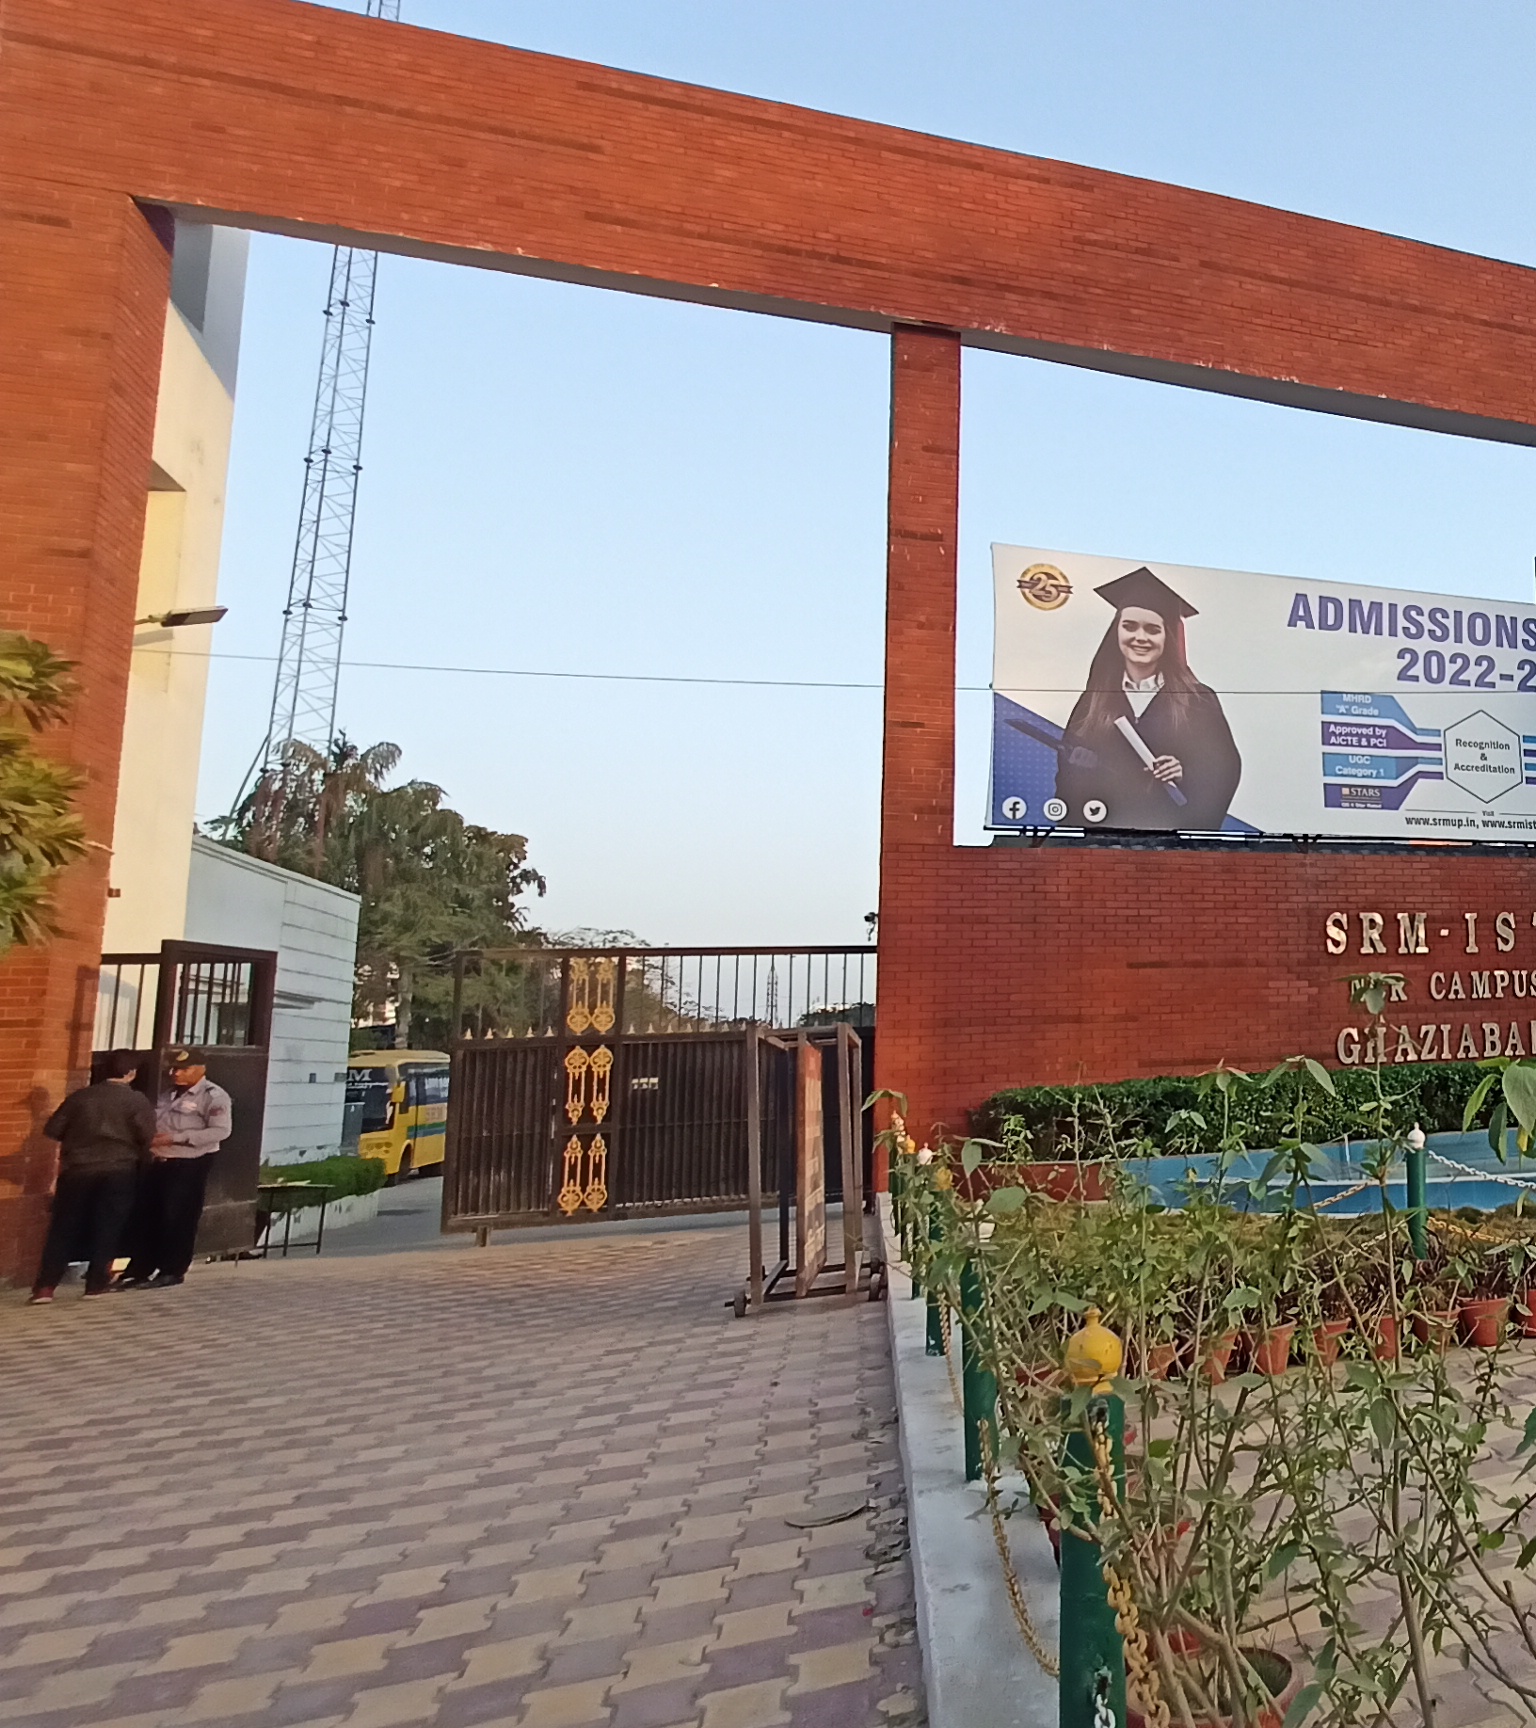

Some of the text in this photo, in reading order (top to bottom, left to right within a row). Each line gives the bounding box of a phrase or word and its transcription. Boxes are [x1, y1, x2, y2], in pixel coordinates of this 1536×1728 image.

[1029, 572, 1061, 602] 25
[1342, 693, 1372, 704] MHRD
[1351, 705, 1380, 716] Grade
[1328, 723, 1388, 738] Approved by
[1329, 736, 1387, 747] AICTE & PCI
[1455, 738, 1511, 751] Recognition
[1348, 755, 1371, 765] UGC
[1480, 752, 1488, 761] &
[1335, 765, 1385, 778] Category 1
[1453, 762, 1516, 774] Accreditation
[1350, 787, 1381, 797] STARS
[1404, 816, 1480, 829] www.srmup.in,
